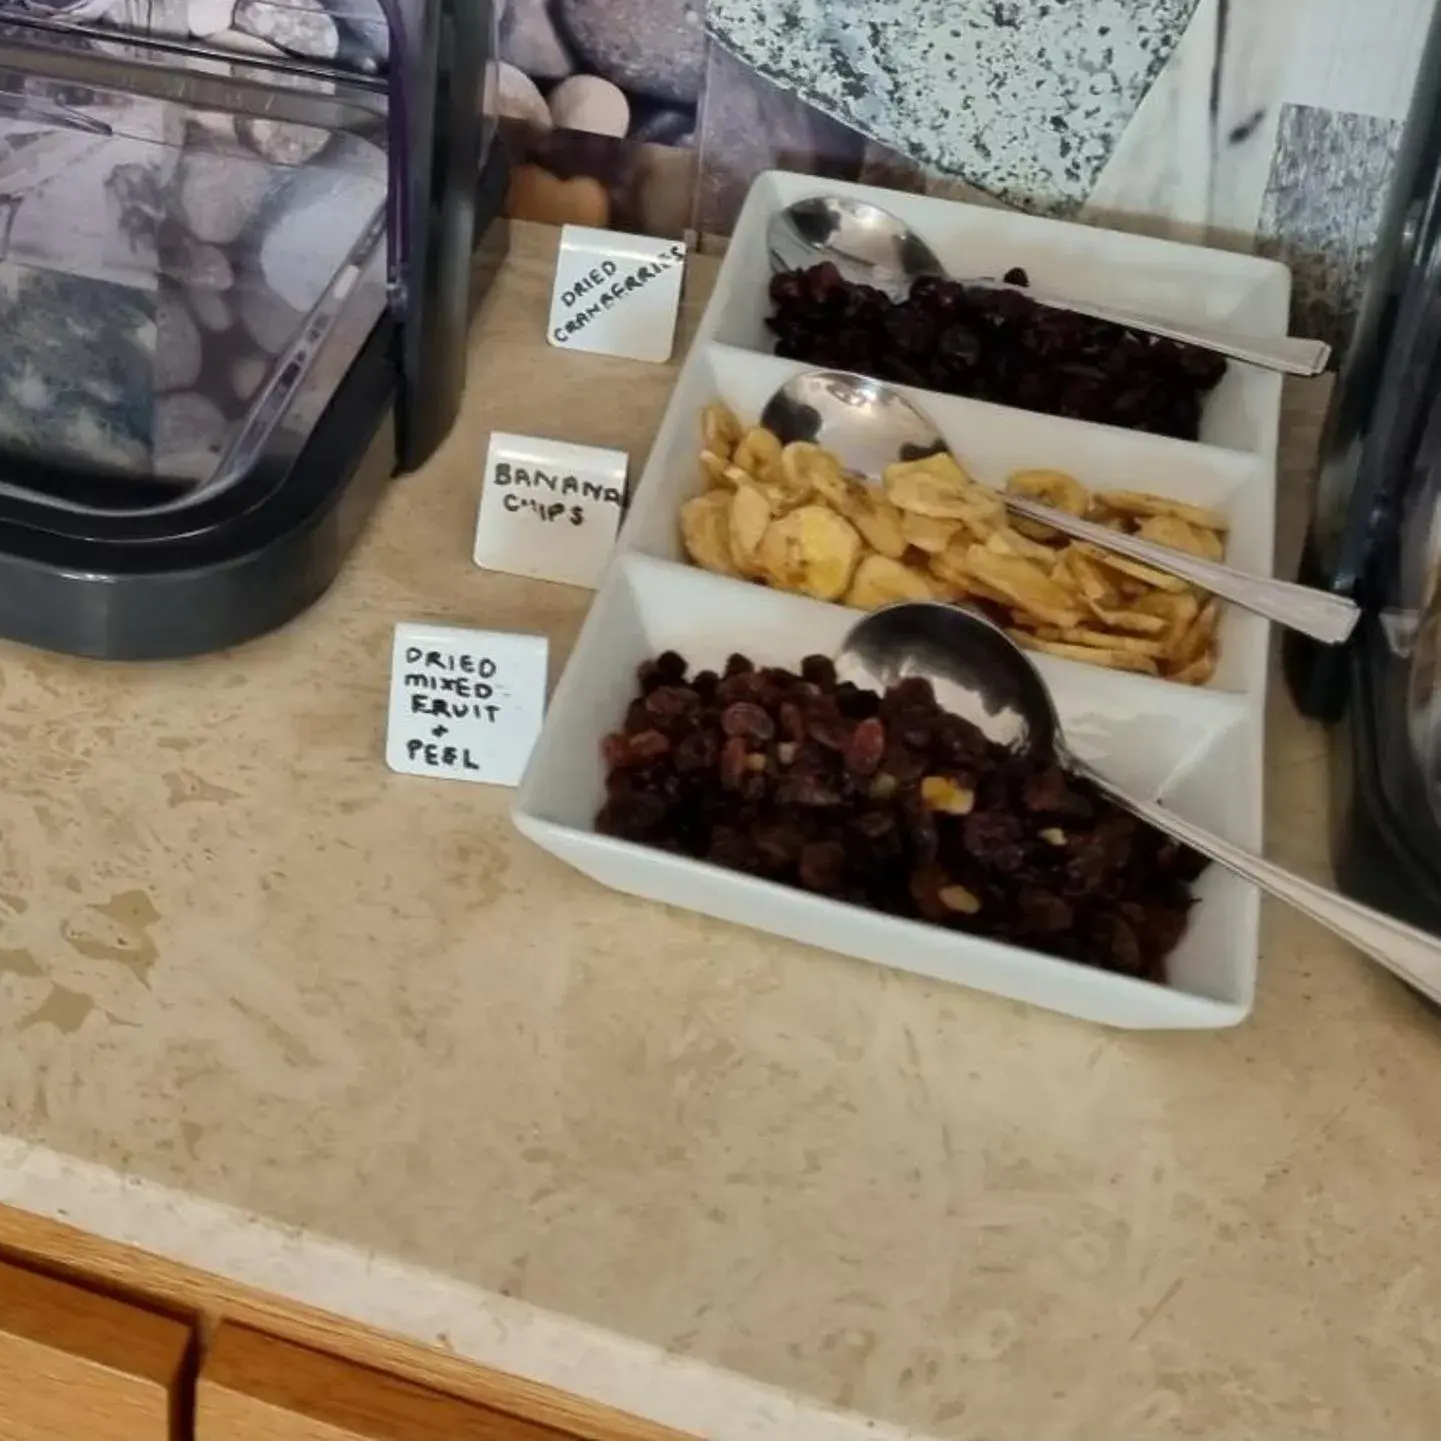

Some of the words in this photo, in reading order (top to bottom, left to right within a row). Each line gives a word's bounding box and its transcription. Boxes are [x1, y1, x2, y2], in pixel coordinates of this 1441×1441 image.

[560, 260, 617, 308] DRIED
[493, 462, 622, 506] BANANA
[405, 647, 498, 679] DRIED
[404, 673, 494, 699] MIXED
[411, 693, 502, 722] FRUIT
[406, 739, 480, 770] PEEL
